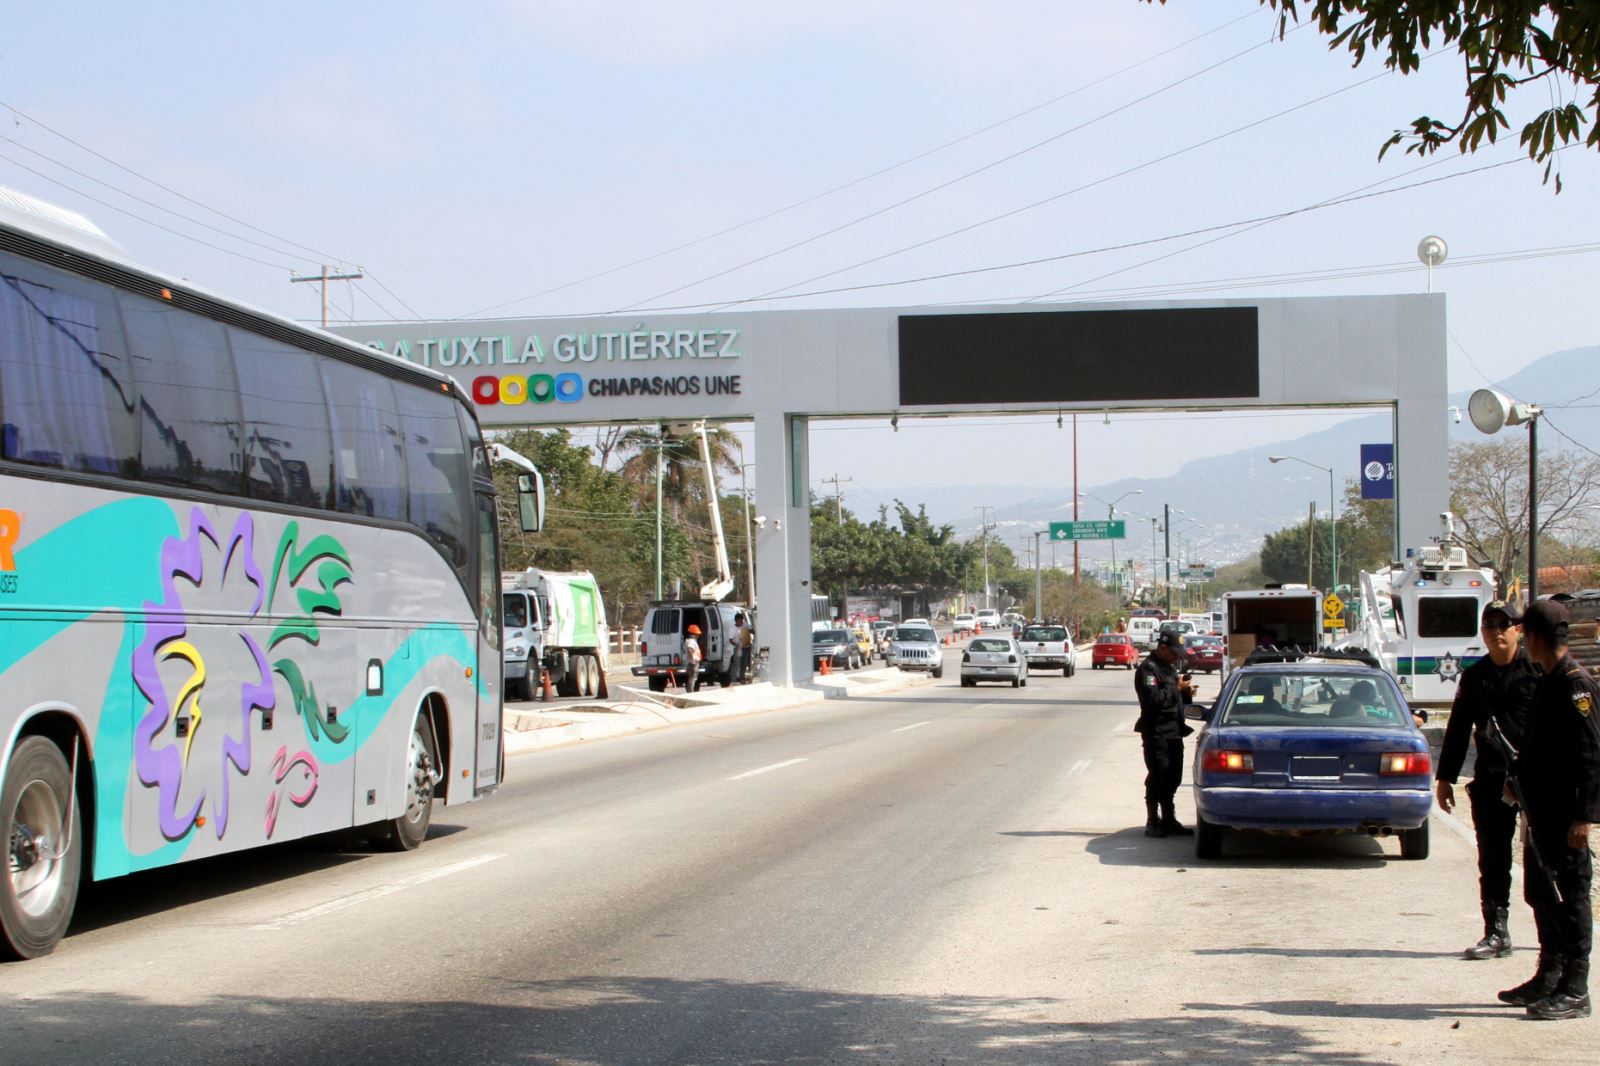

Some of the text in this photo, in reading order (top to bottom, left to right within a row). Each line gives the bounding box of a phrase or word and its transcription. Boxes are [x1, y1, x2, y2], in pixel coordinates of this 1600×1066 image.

[417, 335, 545, 367] TUXTLA
[552, 324, 739, 361] GUTIÉRREZ
[705, 375, 741, 395] UNE
